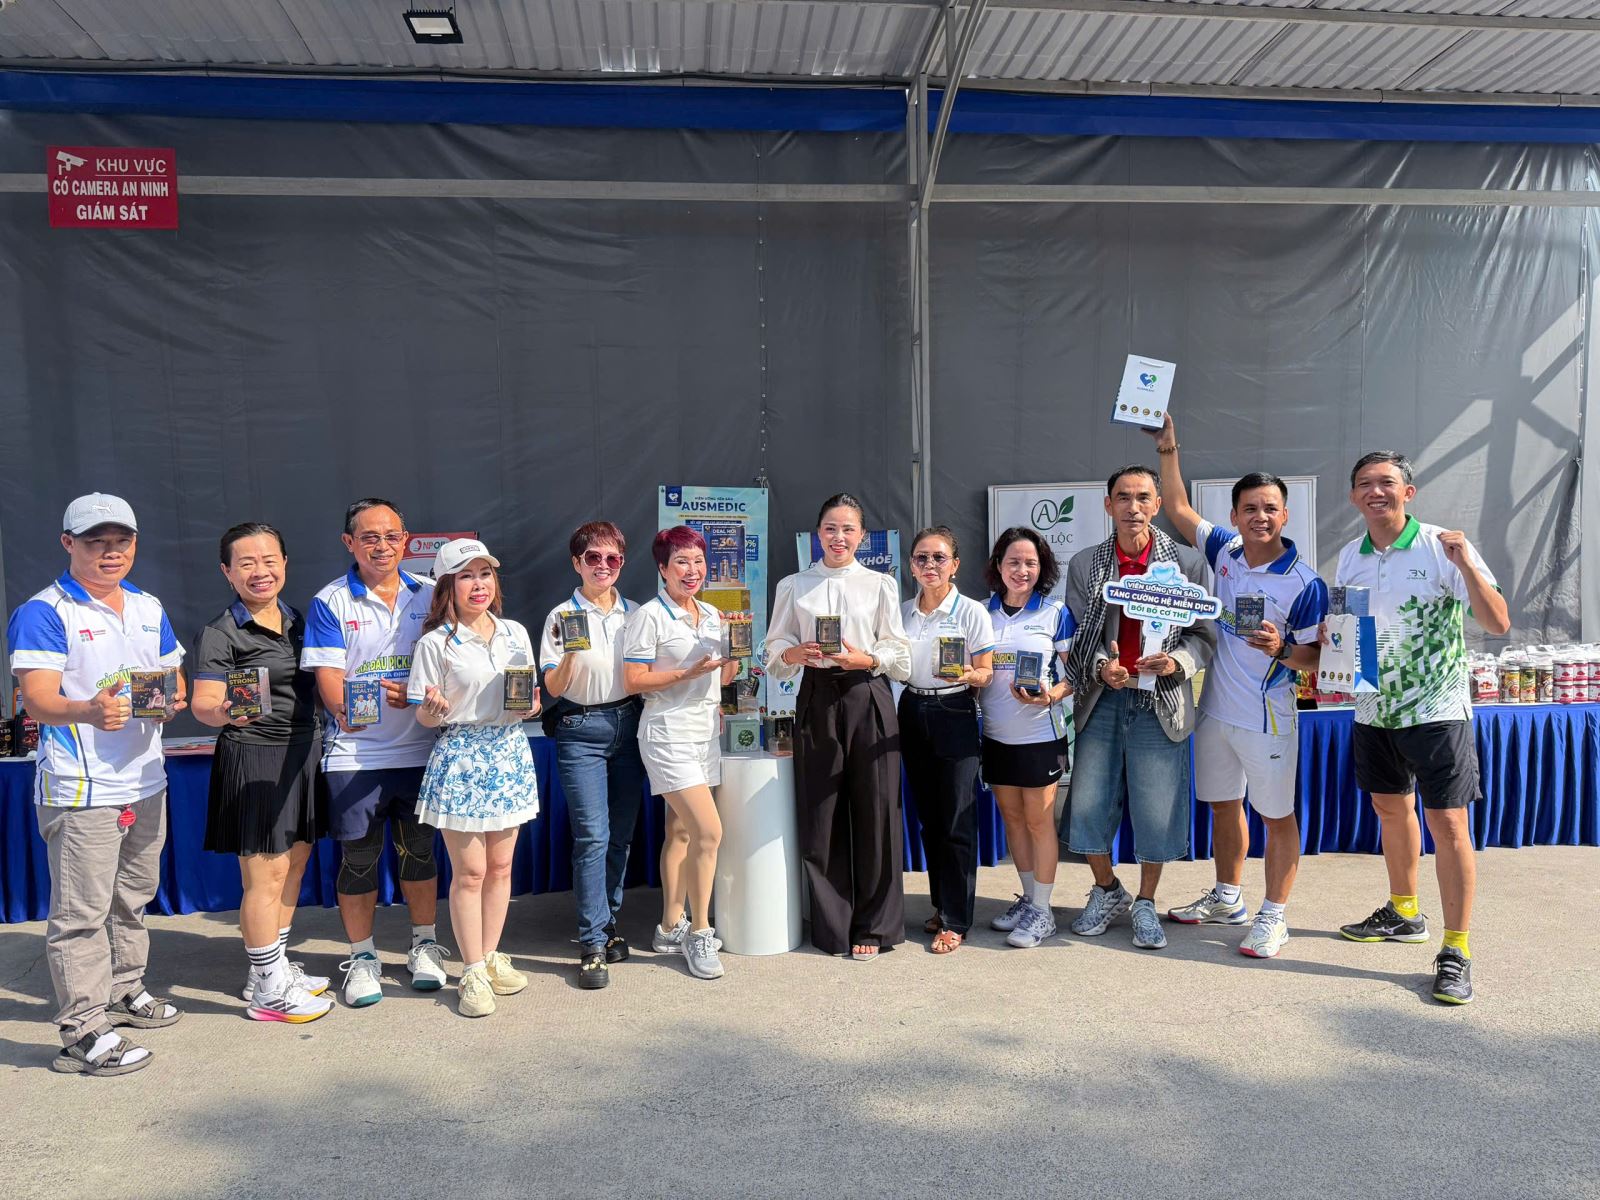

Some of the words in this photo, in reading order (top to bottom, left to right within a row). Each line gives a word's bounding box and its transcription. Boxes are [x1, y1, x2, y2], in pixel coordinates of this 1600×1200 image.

[96, 159, 129, 172] KHU
[134, 157, 167, 175] VỰC
[53, 176, 69, 195] CÓ
[72, 180, 119, 196] CAMERA
[122, 181, 138, 196] AN
[140, 181, 169, 197] NINH
[76, 201, 115, 220] GIÁM
[120, 202, 148, 221] SÁT
[681, 501, 746, 512] AUSMEDIC
[1051, 532, 1073, 546] LỘC
[860, 552, 892, 566] KHỎE
[1127, 581, 1144, 590] VIÊN
[1146, 583, 1166, 593] UỐNG
[1168, 585, 1182, 595] YẾN
[1183, 588, 1200, 598] SÀO
[1109, 587, 1130, 599] TĂNG
[1131, 591, 1159, 604] CƯỜNG
[1161, 596, 1172, 608] HỆ
[1173, 597, 1194, 609] MIỄN
[1195, 602, 1215, 613] DỊCH
[1160, 608, 1171, 616] CƠ
[1172, 609, 1188, 619] THỂ
[371, 651, 388, 671] ĐẤU
[229, 677, 258, 685] STRONG
